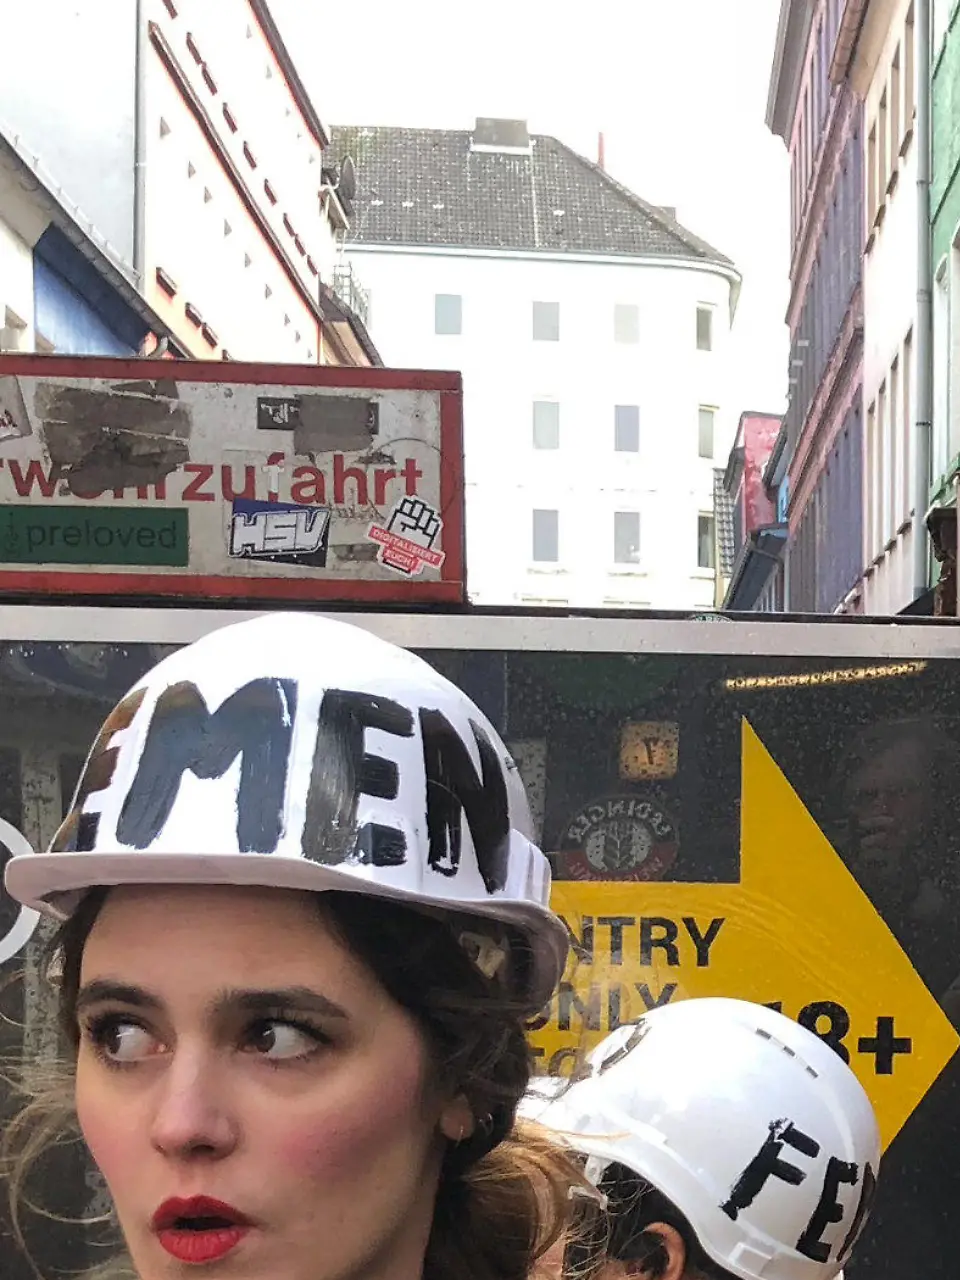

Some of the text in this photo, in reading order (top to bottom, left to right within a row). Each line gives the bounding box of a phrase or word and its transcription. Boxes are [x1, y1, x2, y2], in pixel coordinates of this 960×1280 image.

[27, 519, 177, 552] preloved
[233, 509, 329, 554] HSV
[557, 916, 726, 967] NTRY
[761, 1001, 912, 1075] 8+
[719, 1117, 876, 1263] FE
